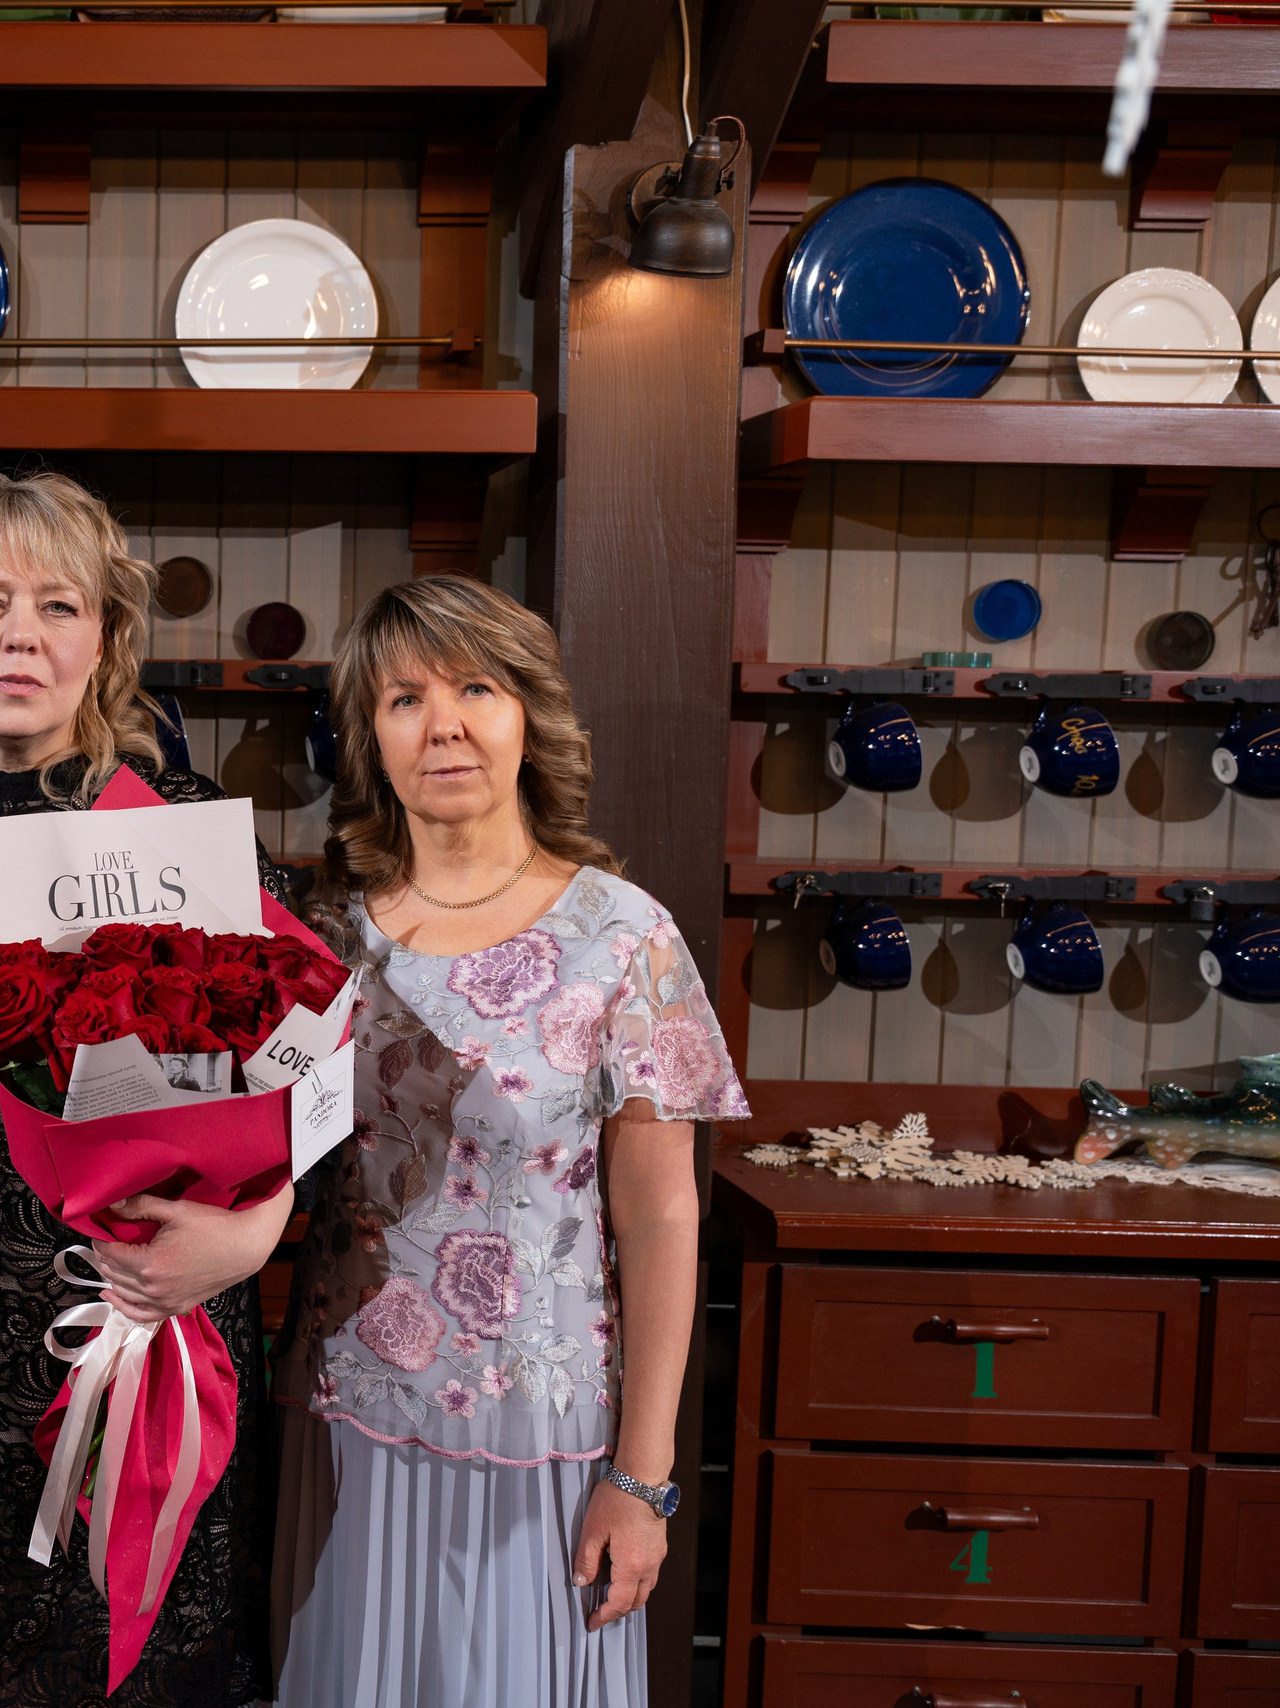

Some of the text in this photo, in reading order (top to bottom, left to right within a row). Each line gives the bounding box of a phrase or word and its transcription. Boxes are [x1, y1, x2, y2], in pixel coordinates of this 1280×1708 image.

[93, 850, 134, 872] LOVE
[48, 866, 187, 922] GIRLS
[266, 1039, 315, 1076] LOVE
[950, 1530, 993, 1584] 4
